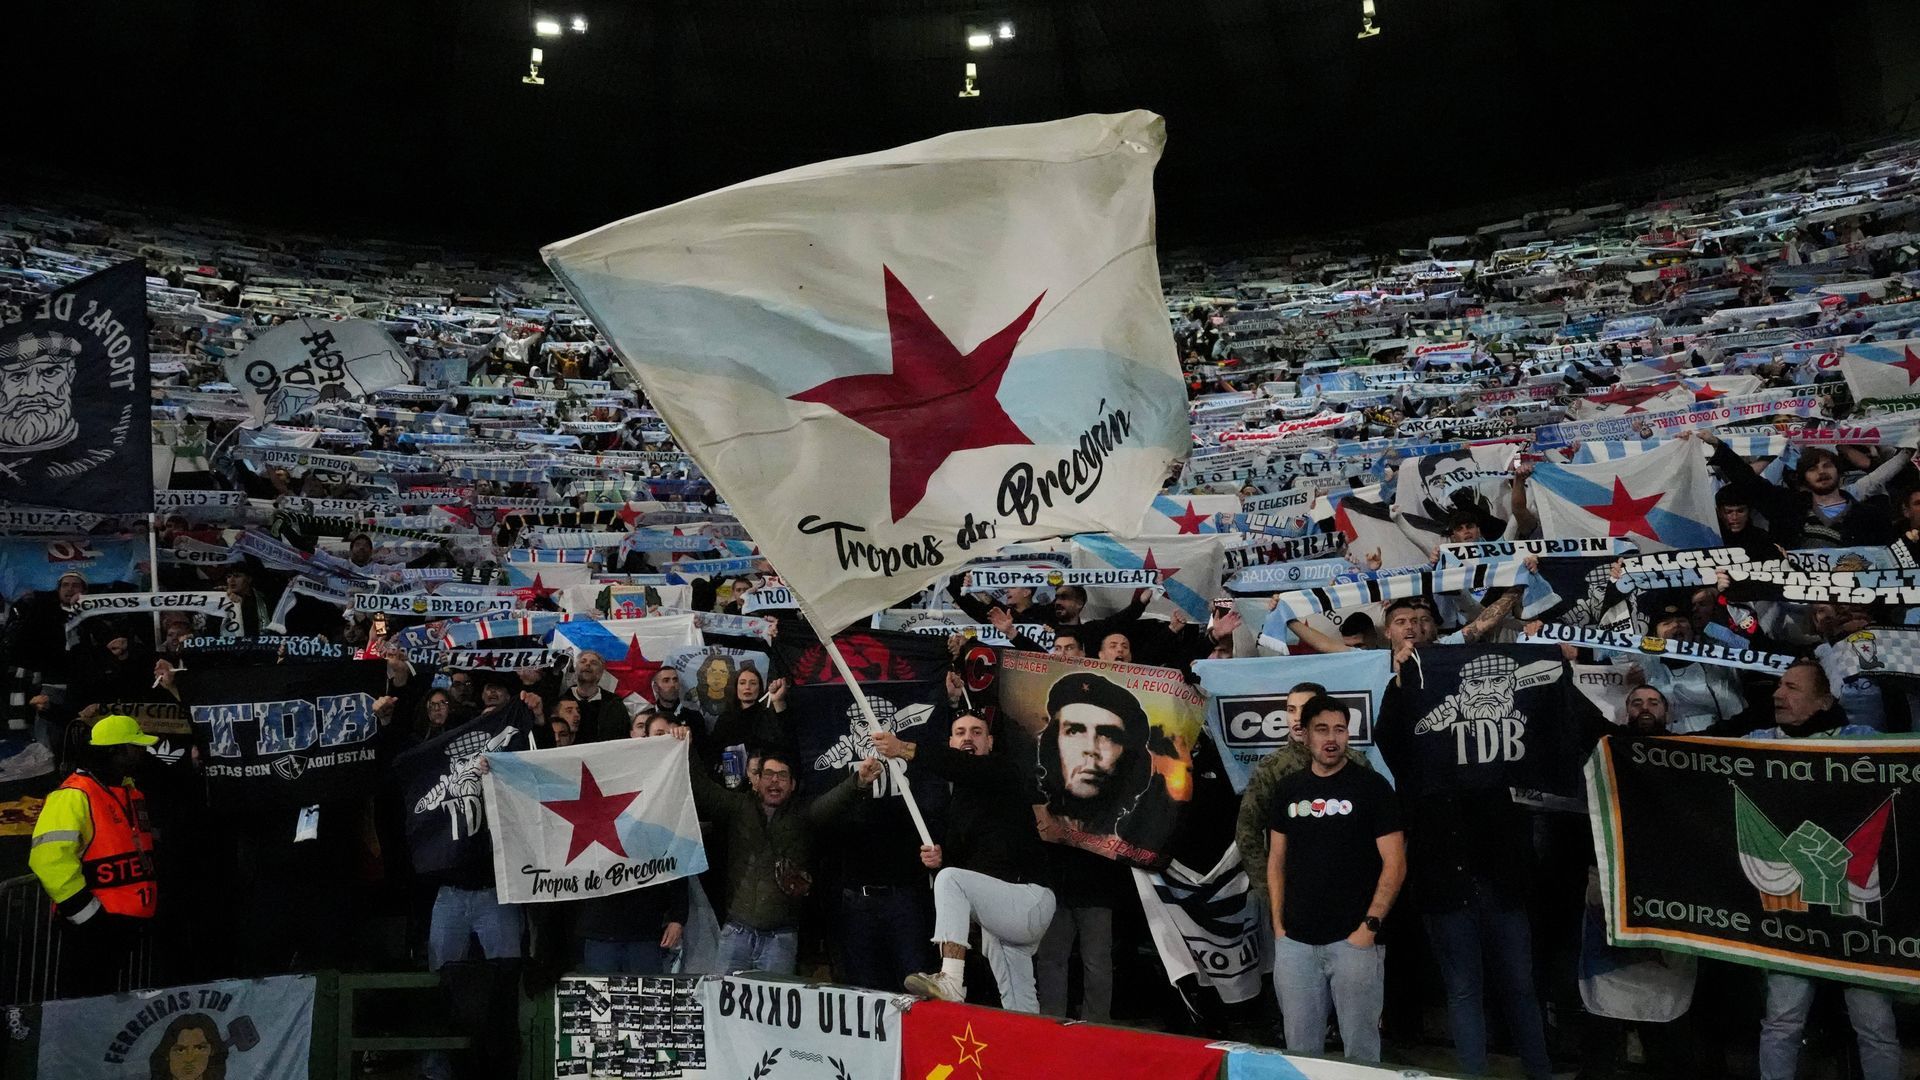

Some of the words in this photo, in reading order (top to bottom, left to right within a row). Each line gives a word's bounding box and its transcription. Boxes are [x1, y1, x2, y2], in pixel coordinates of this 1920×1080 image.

[1399, 417, 1484, 433] CARCAMAN
[797, 514, 943, 577] Tropas
[996, 398, 1131, 526] Breogán
[174, 548, 228, 563] Celta
[972, 570, 1045, 586] TROPAS
[355, 595, 410, 611] ROPAS
[190, 692, 378, 758] TDB
[1451, 717, 1526, 765] TDB
[244, 763, 271, 777] SON
[97, 854, 150, 884] STE
[521, 863, 579, 898] Tropas
[584, 869, 603, 892] de
[604, 849, 678, 887] Breogán
[1761, 916, 1831, 949] don
[103, 991, 193, 1064] FERREIRAS
[197, 989, 233, 1012] TDB
[719, 980, 801, 1029] BAIXO
[818, 991, 888, 1042] ULLA
